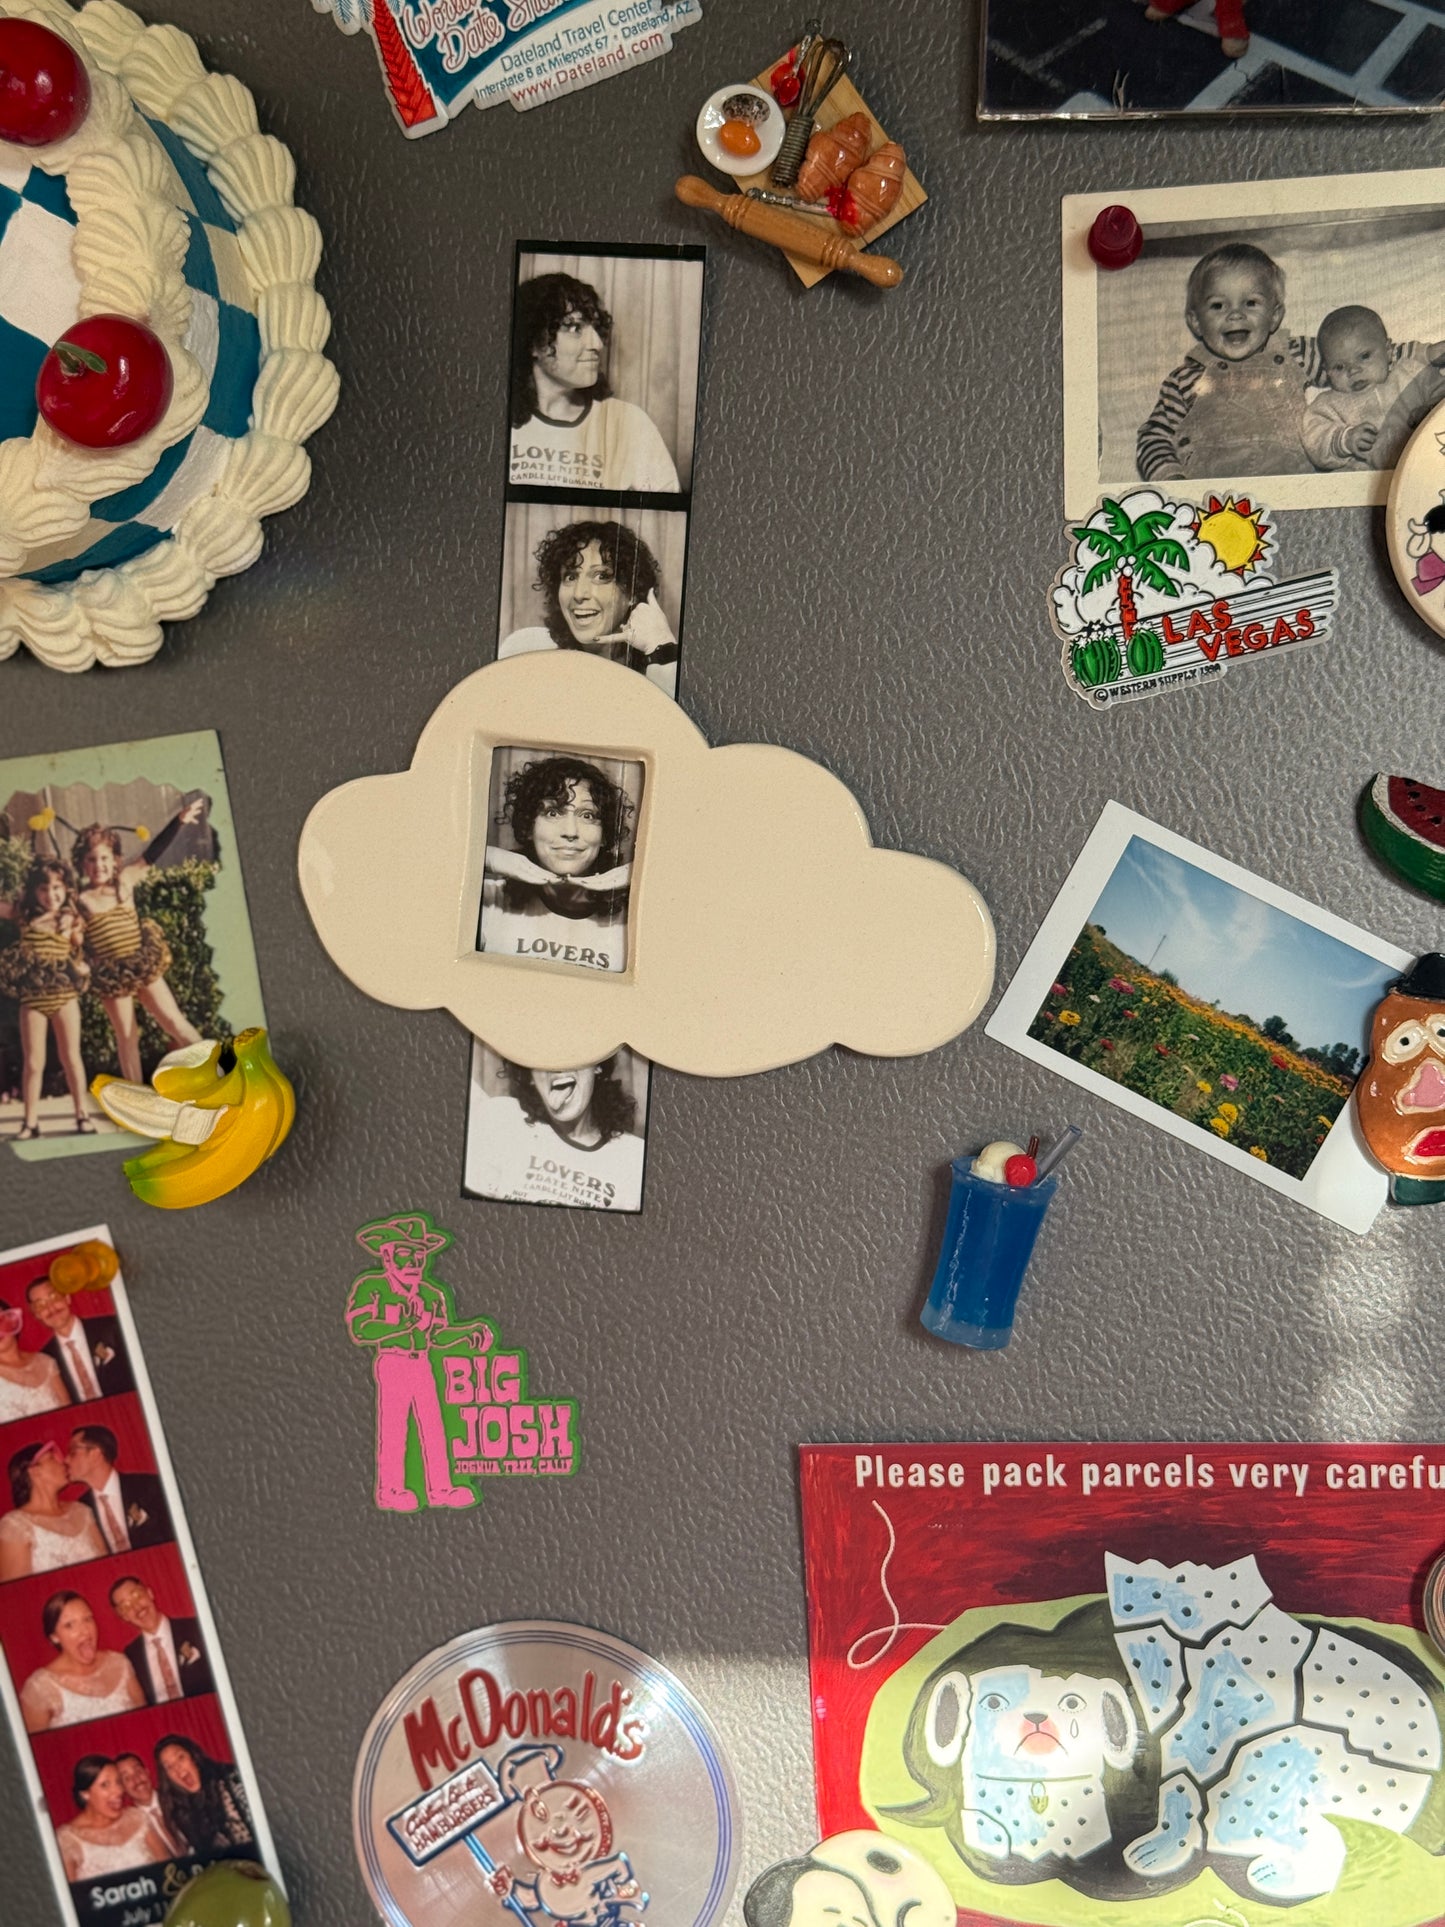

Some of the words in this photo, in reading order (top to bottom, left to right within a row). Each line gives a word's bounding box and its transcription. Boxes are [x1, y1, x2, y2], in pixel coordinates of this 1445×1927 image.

[441, 9, 502, 70] Date
[475, 71, 525, 99] Interstate
[525, 66, 534, 79] 8
[536, 62, 547, 75] at
[547, 42, 594, 71] Milepost
[594, 35, 608, 50] 67
[675, 0, 693, 17] AZ
[500, 33, 562, 72] Dateland
[562, 15, 606, 46] Travel
[608, 0, 653, 26] Center
[513, 33, 664, 101] www.Dateland.com
[512, 444, 605, 469] LOVERS
[1161, 599, 1233, 645] LAS
[1196, 609, 1315, 662] VEGAS
[1109, 679, 1157, 698] WESTERN
[516, 937, 611, 969] LOVERS
[529, 1155, 616, 1199] LOVERS
[442, 1354, 521, 1405] BIG
[452, 1404, 574, 1459] JOSH
[454, 1460, 501, 1475] JOSHUA
[855, 1454, 965, 1488] Please
[983, 1454, 1067, 1496] pack
[1082, 1454, 1215, 1496] parcels
[1229, 1462, 1309, 1497] very
[403, 1668, 647, 1791] McDonald's
[411, 1788, 498, 1852] HAMBURGERS
[91, 1876, 158, 1909] Sarah
